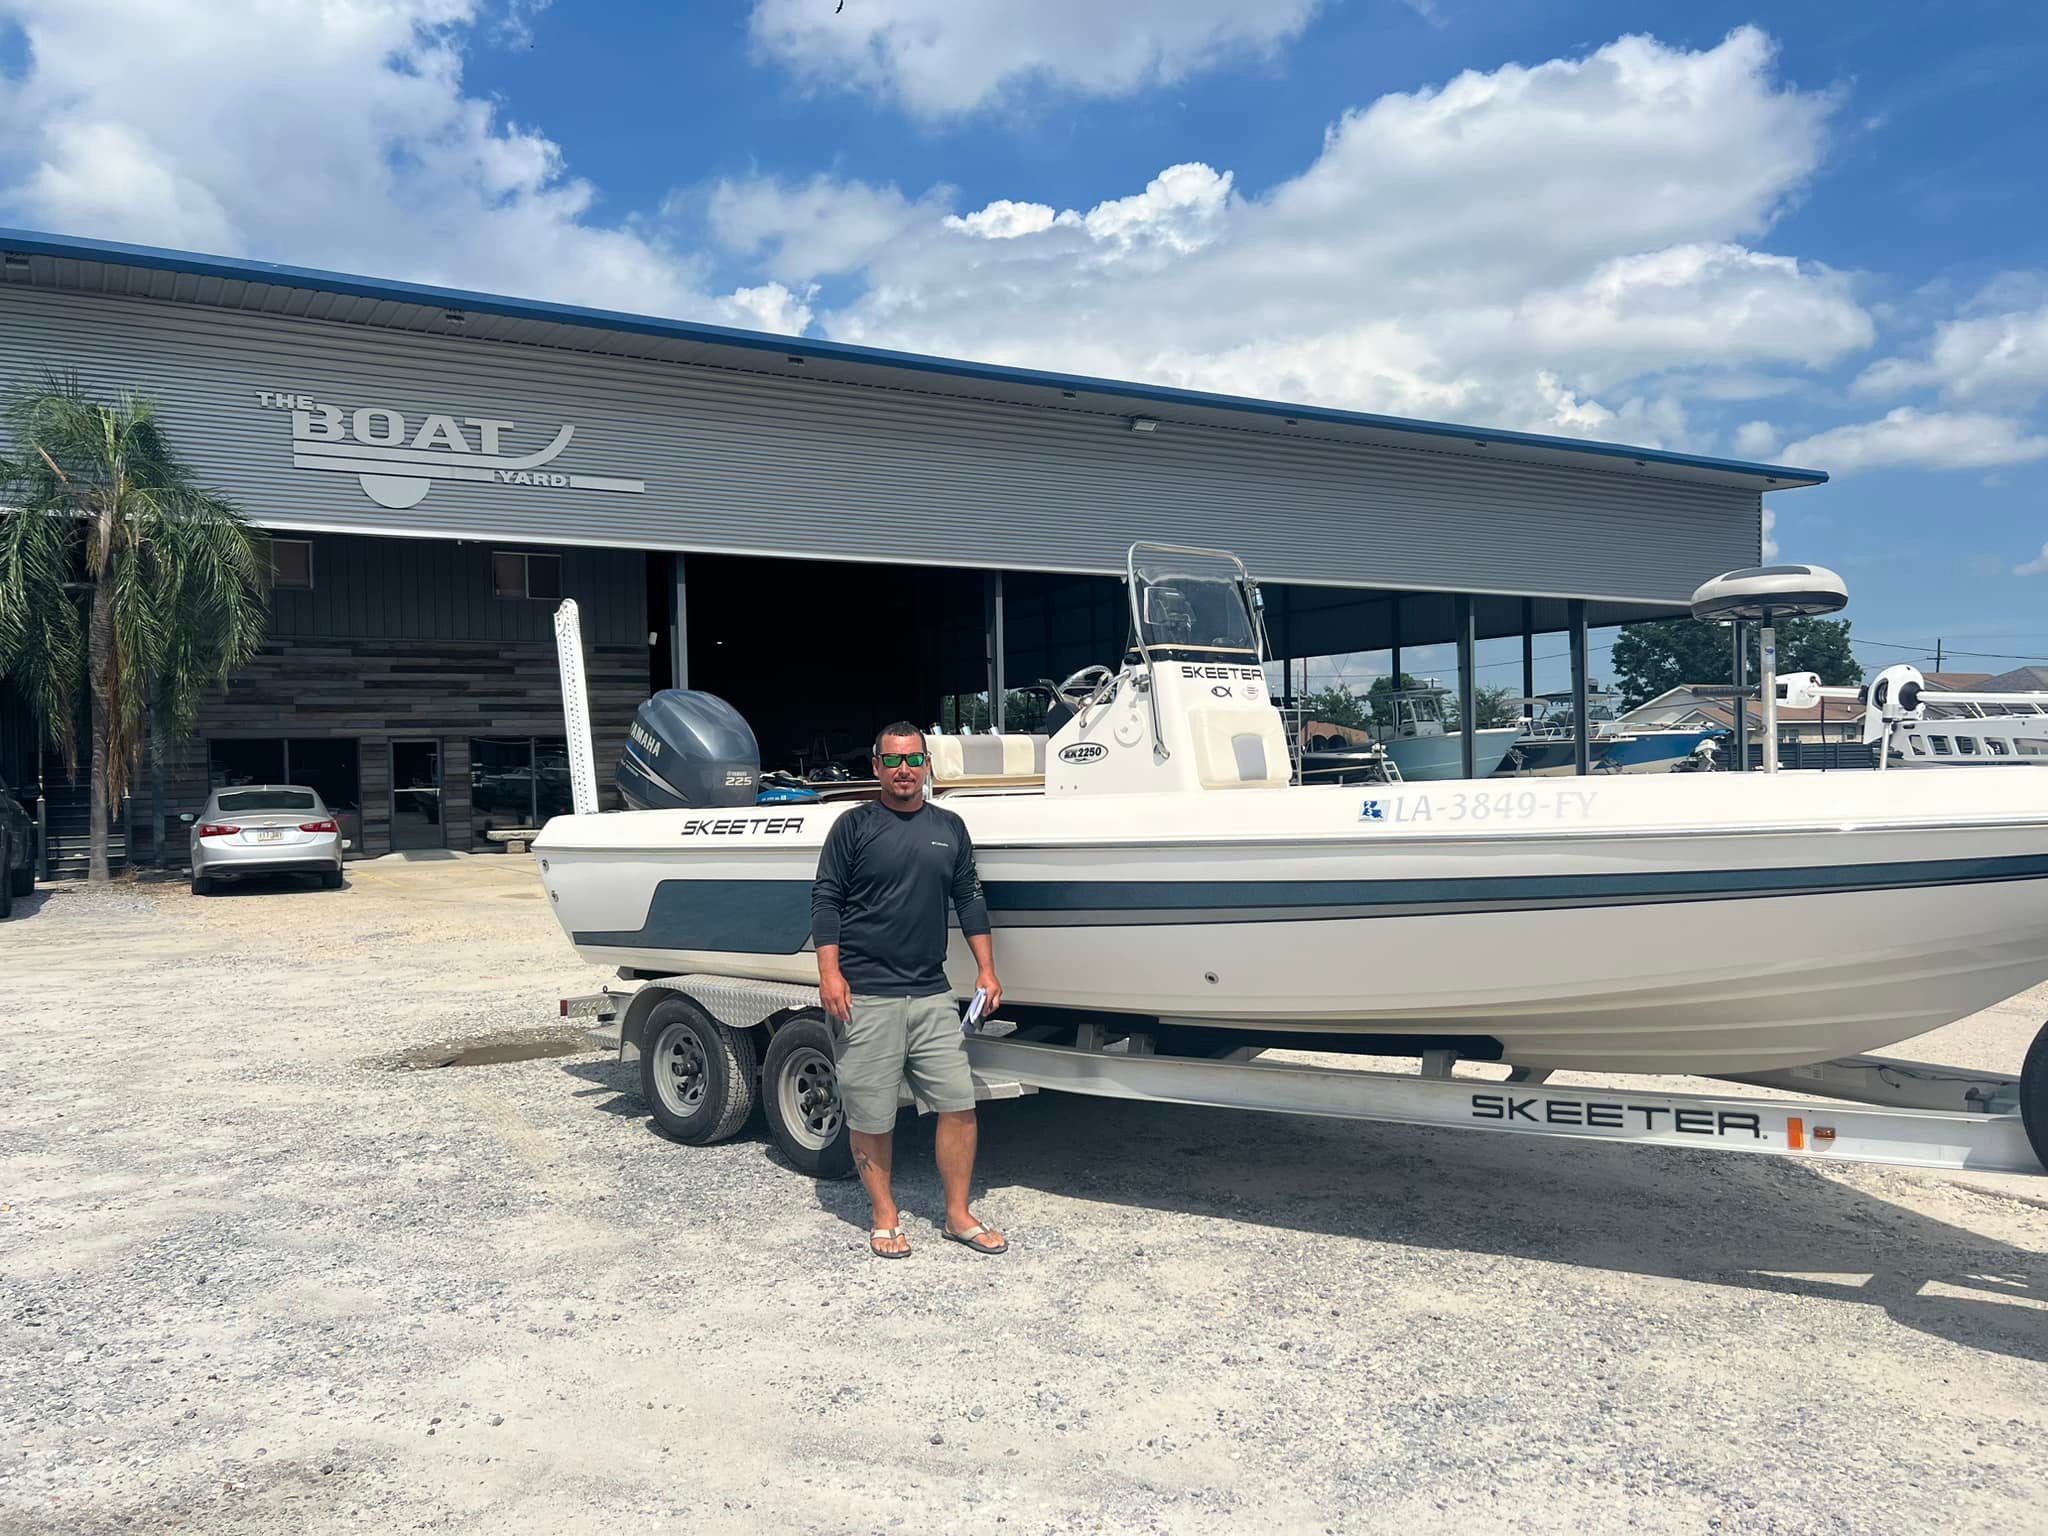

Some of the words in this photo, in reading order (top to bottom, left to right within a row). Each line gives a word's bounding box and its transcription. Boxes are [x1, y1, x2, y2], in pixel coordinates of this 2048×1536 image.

[255, 390, 316, 410] THE
[292, 403, 514, 456] BOAT
[499, 469, 567, 488] YARD
[1181, 666, 1264, 681] SKEETER
[630, 720, 661, 757] YAMAHA
[725, 776, 753, 786] 225
[1394, 791, 1599, 823] LA-3849-FY
[681, 817, 804, 836] SKEETER
[1472, 1094, 1763, 1139] SKEETER
